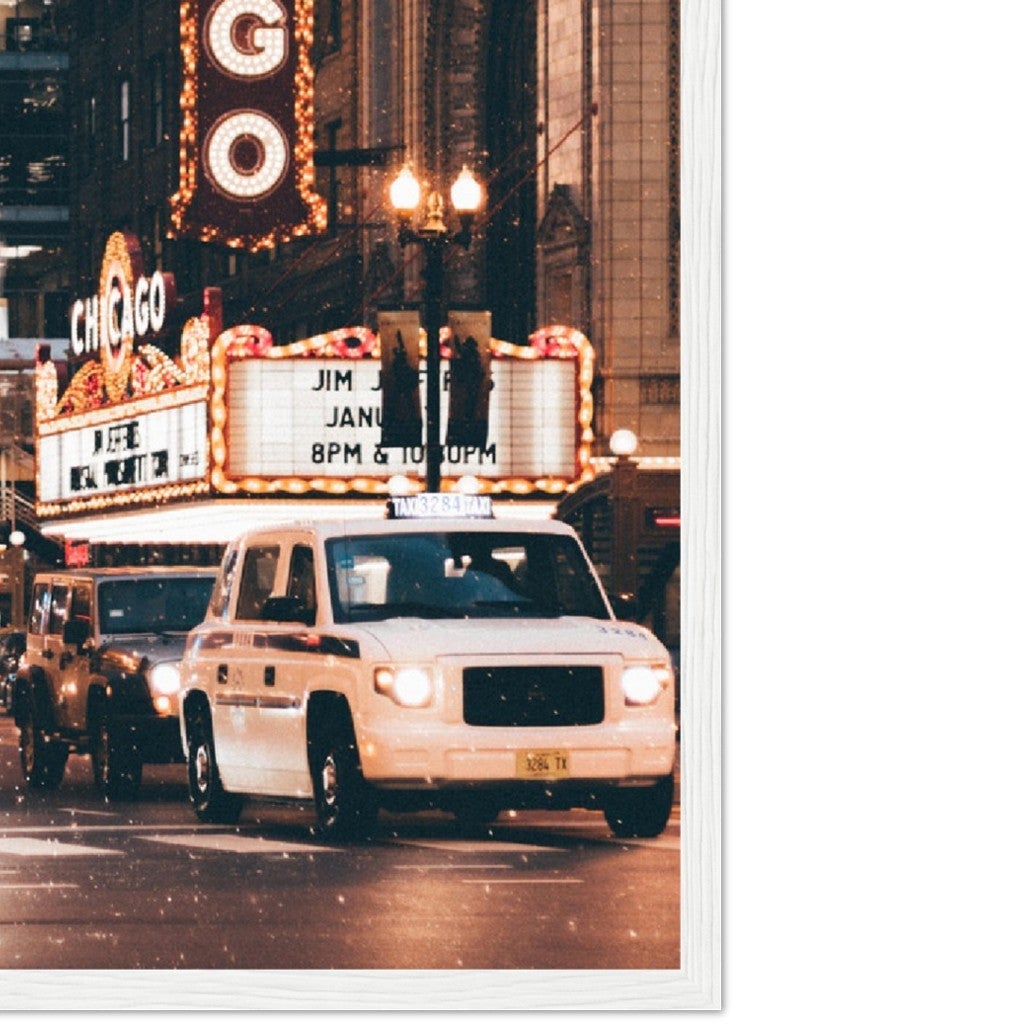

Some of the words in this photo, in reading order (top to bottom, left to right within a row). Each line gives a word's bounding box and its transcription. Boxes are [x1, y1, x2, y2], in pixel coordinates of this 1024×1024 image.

[71, 270, 165, 356] CHICAGO
[312, 369, 352, 391] JIM
[312, 443, 362, 464] 8PM
[420, 495, 461, 514] 3284
